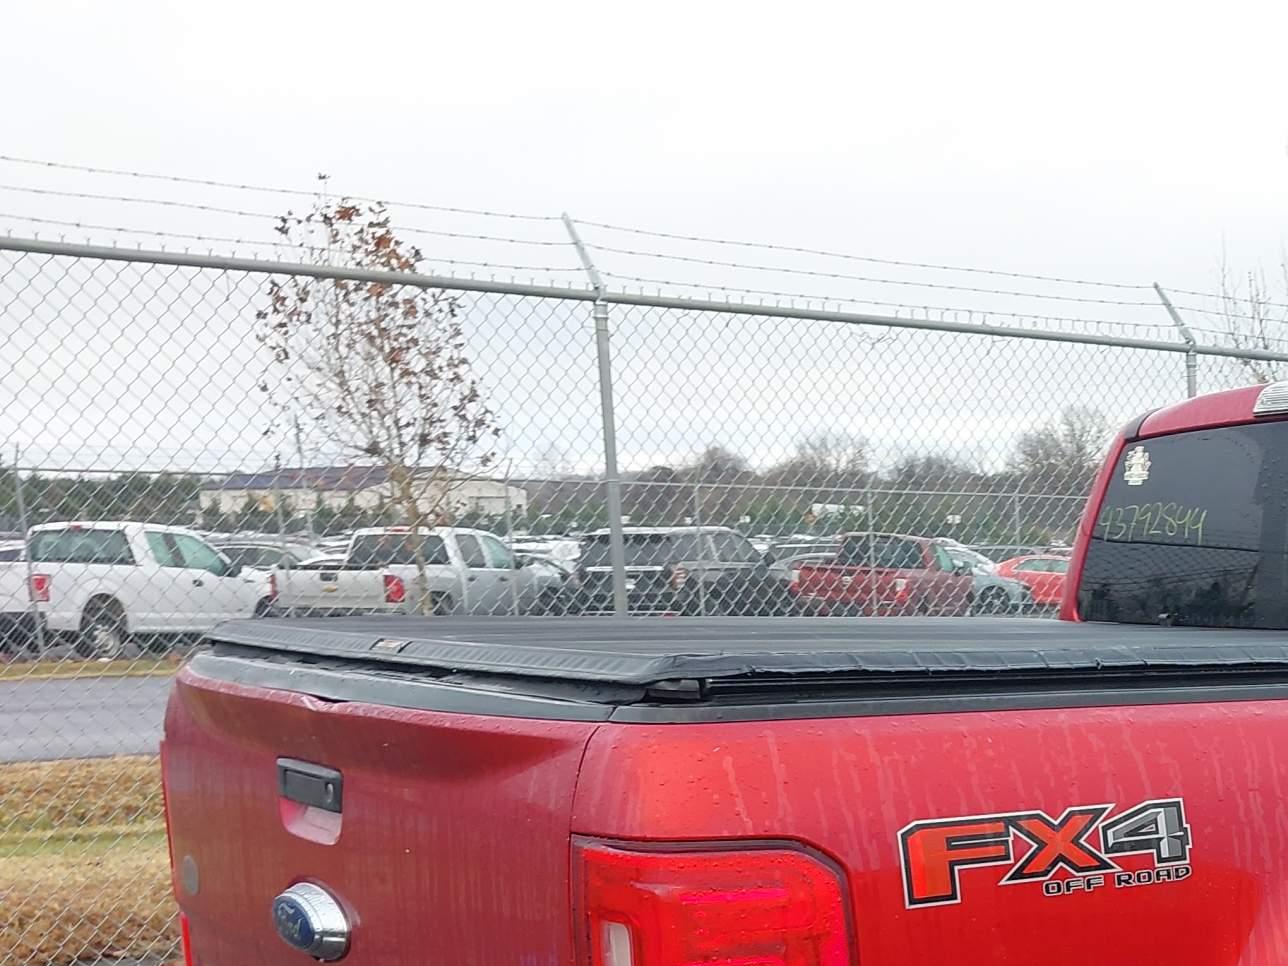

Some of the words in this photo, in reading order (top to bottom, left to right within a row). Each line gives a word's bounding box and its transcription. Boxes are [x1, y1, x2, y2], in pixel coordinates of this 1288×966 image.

[1099, 502, 1207, 545] 43792844
[897, 798, 1193, 909] FX4
[1043, 876, 1105, 896] OFF
[1115, 865, 1193, 888] ROAD
